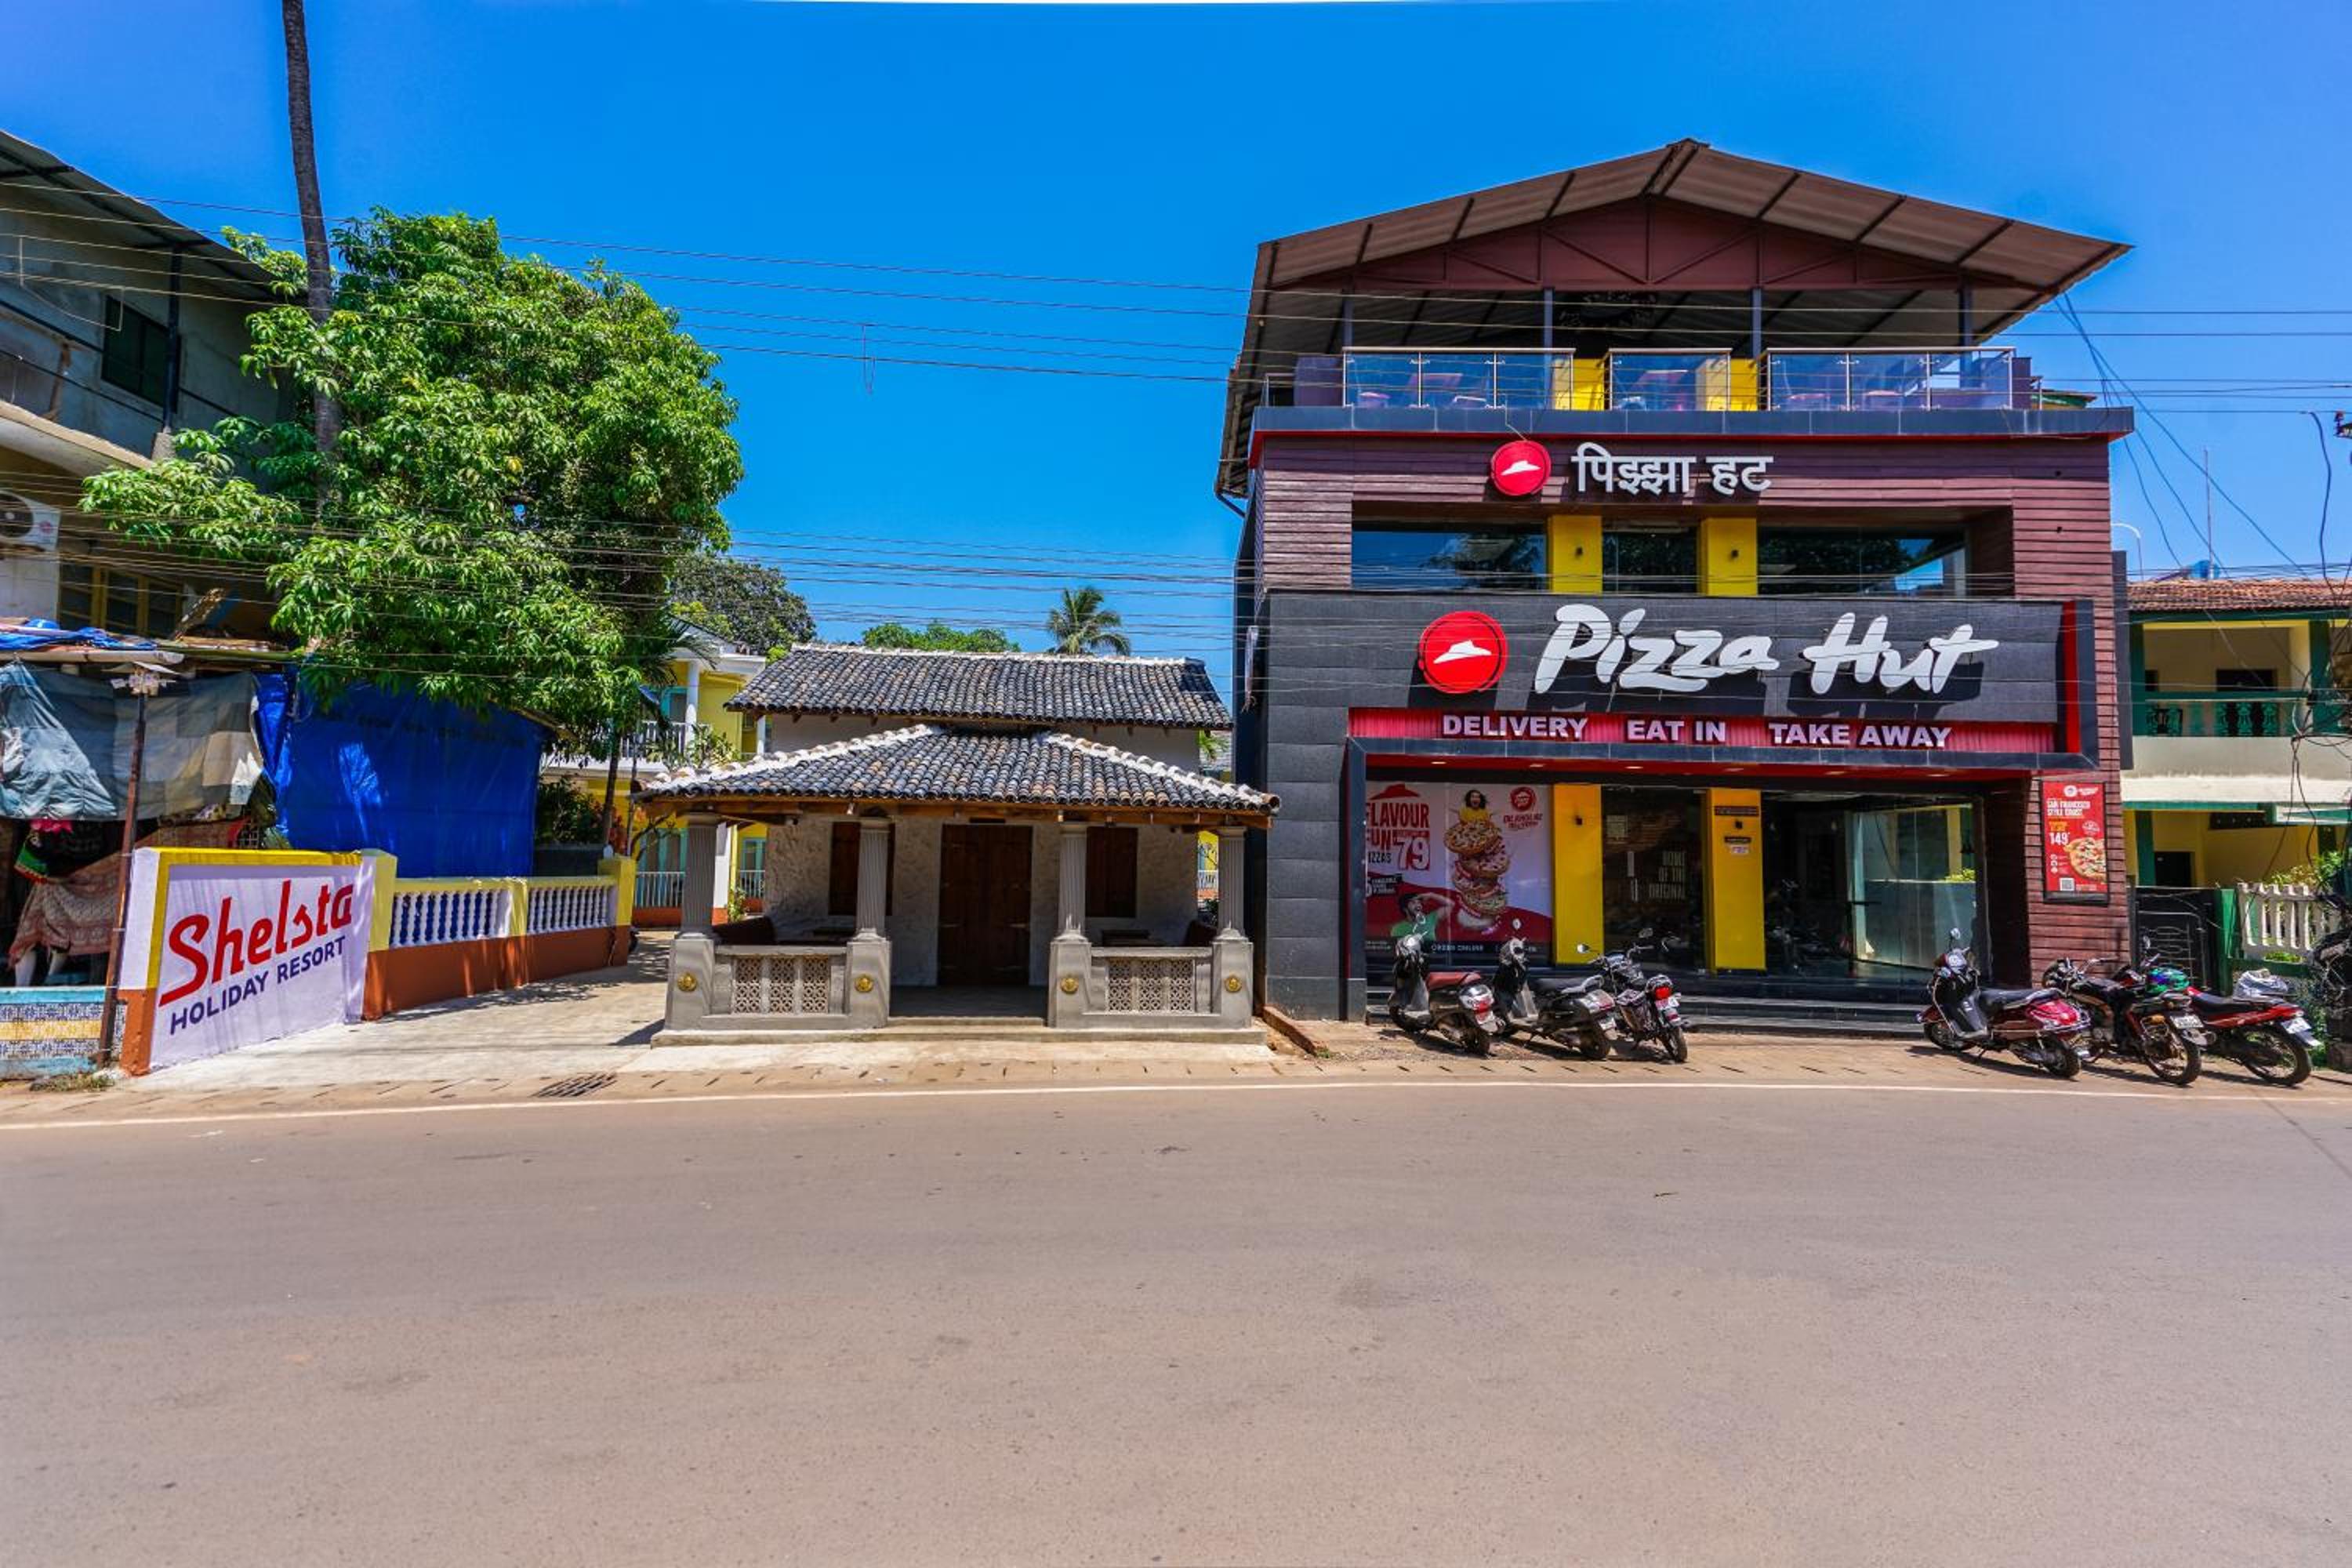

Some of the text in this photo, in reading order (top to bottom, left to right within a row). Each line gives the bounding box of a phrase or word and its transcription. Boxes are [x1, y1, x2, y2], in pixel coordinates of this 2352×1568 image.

[1705, 456, 1773, 495] हट
[1534, 604, 1999, 695] Pizza Hut
[1443, 714, 1951, 748] DELIVERY EAT IN TAKE AWAY
[1367, 852, 1392, 863] IZZAS
[158, 879, 353, 1007] Shelsta
[170, 935, 346, 1035] HOLIDAY RESORT
